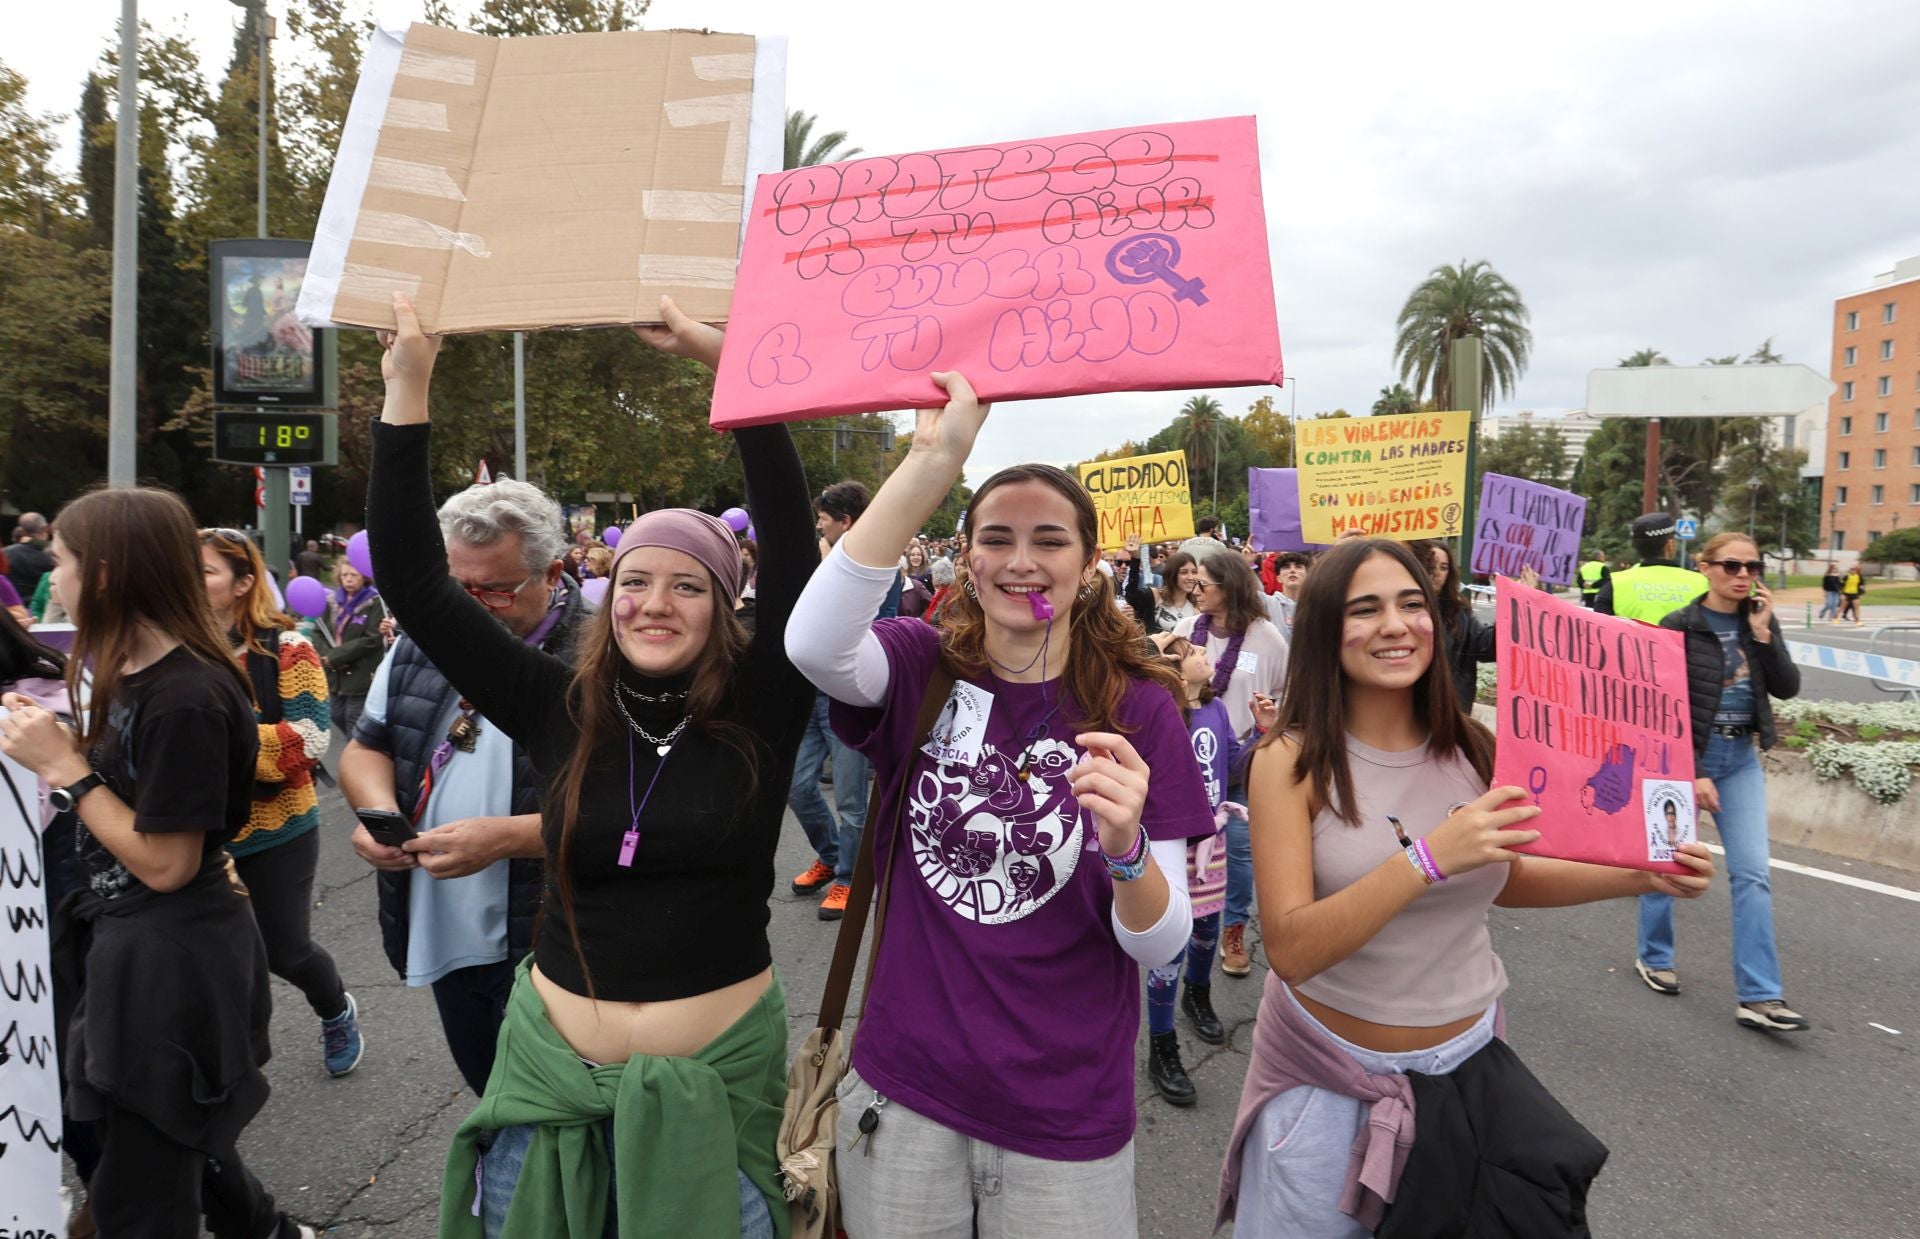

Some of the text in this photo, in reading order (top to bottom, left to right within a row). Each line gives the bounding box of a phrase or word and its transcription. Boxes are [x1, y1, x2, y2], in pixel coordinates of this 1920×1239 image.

[774, 132, 1174, 236] PROTEGE
[797, 226, 865, 280] A
[891, 212, 995, 262] TU
[841, 245, 1095, 318] EDUCA
[748, 323, 812, 388] A
[851, 315, 943, 372] TU
[1302, 425, 1338, 447] LAS
[1305, 449, 1372, 465] CONTRA
[1380, 445, 1405, 461] LAS
[1410, 439, 1465, 458] MADRES
[1085, 458, 1187, 494] CUIDADO!
[1093, 490, 1190, 510] EL MACHISMO
[1309, 493, 1339, 507] SON
[1101, 505, 1167, 544] MATA
[1480, 518, 1500, 540] ES
[1638, 592, 1686, 603] LOCAL
[1538, 611, 1607, 671] GOLPES
[1618, 633, 1661, 688] QUE
[1510, 646, 1574, 708] DUELEN
[1602, 674, 1685, 739] PALABRAS
[1512, 696, 1554, 748] QUE
